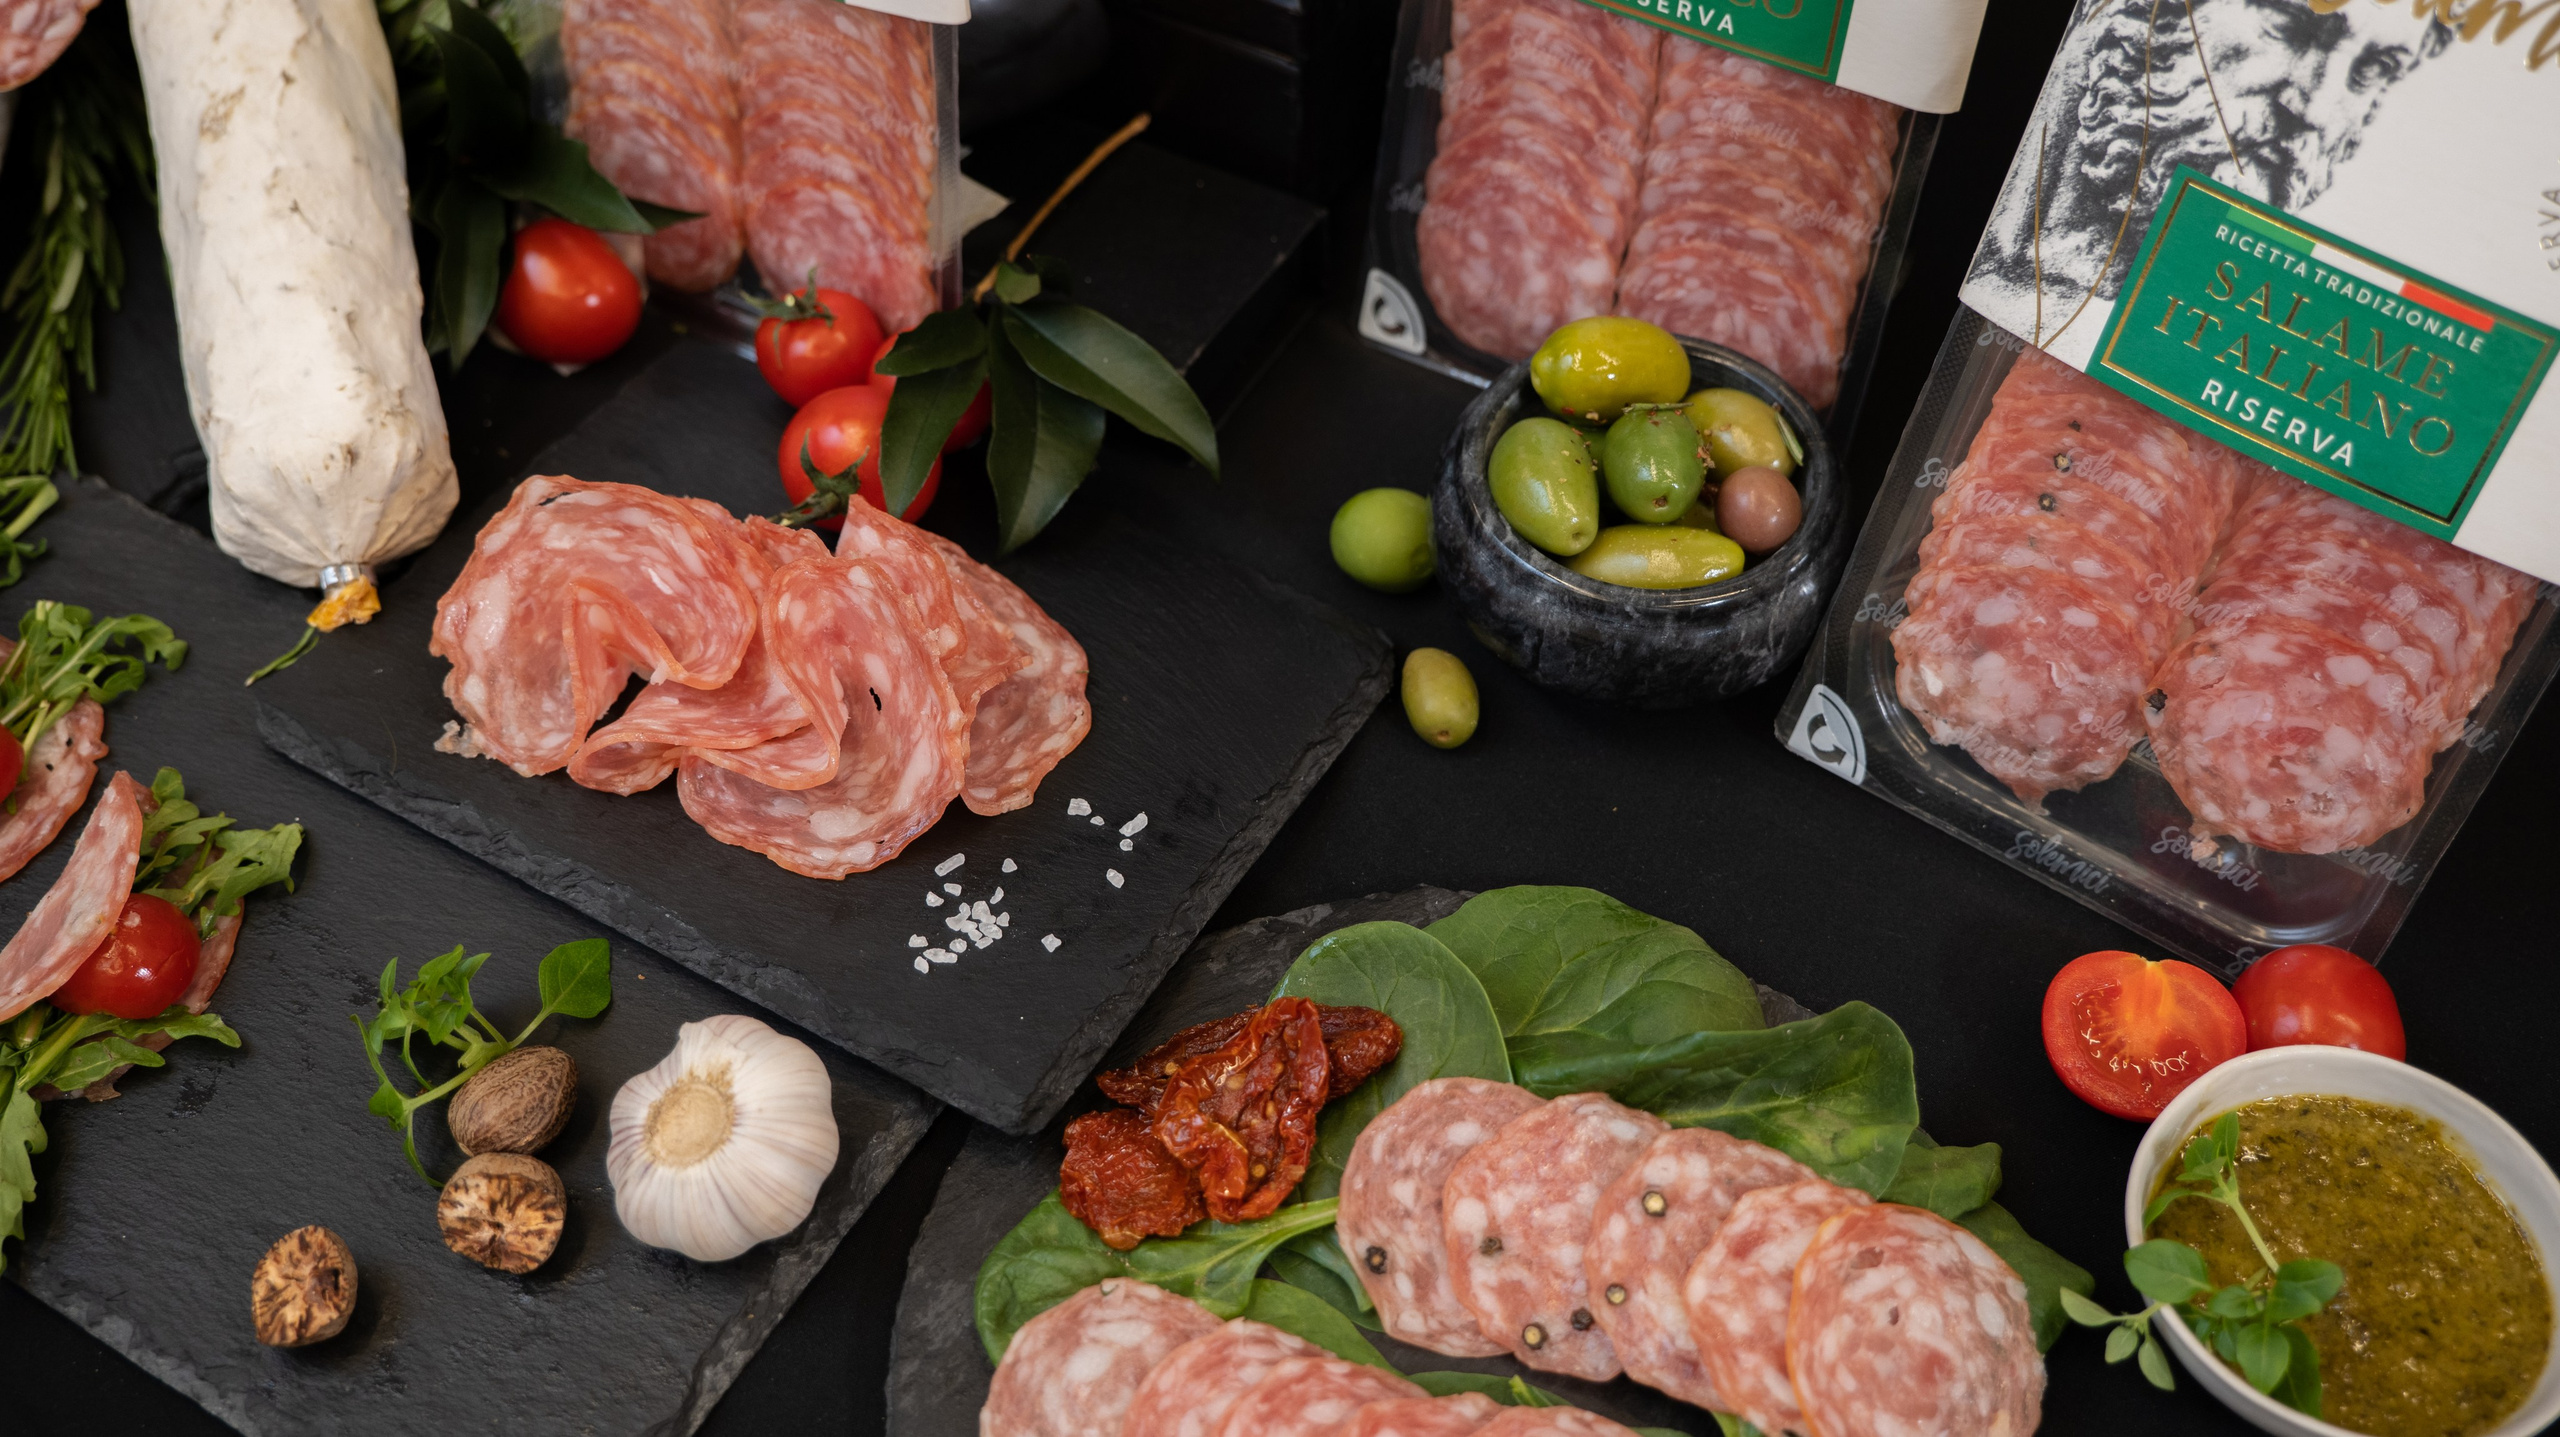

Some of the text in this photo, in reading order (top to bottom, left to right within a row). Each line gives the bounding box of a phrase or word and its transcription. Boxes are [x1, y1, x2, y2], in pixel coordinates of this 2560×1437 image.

[2205, 261, 2456, 399] SALAME
[2214, 224, 2486, 354] RICETTA TRADIZIONALE
[2153, 295, 2455, 456] ITALIANO
[2200, 378, 2355, 468] RISERVA
